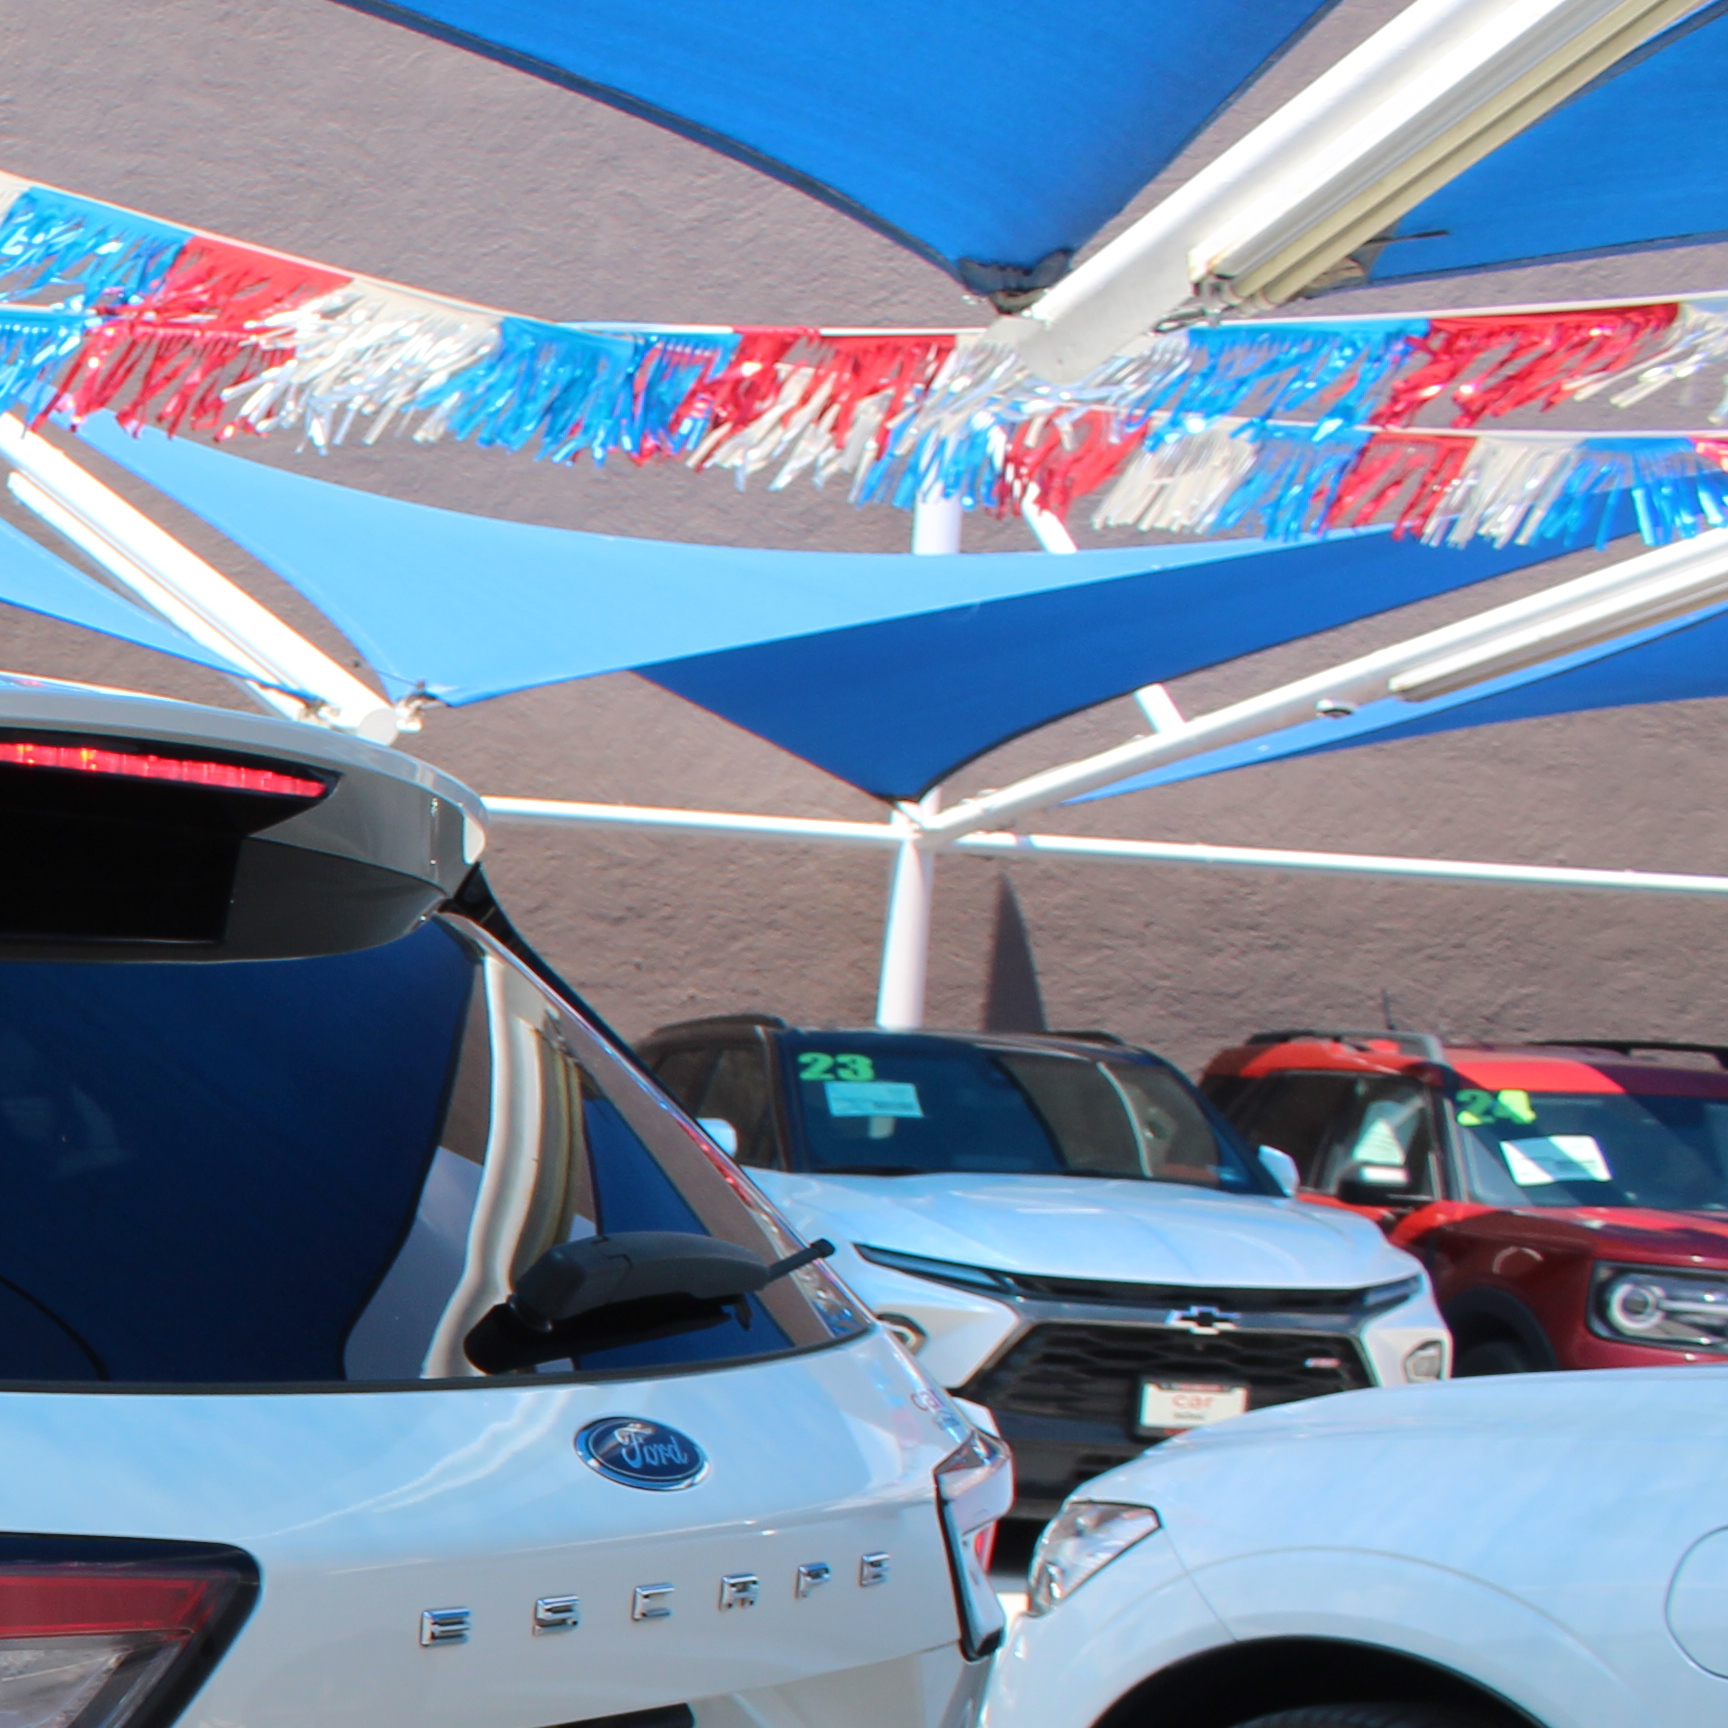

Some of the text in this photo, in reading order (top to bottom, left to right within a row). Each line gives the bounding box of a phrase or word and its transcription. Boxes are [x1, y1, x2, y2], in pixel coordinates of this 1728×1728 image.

[797, 1052, 875, 1081] 23
[1456, 1088, 1537, 1126] 24
[614, 1423, 688, 1469] Ford
[419, 1551, 891, 1648] ESCAPE
